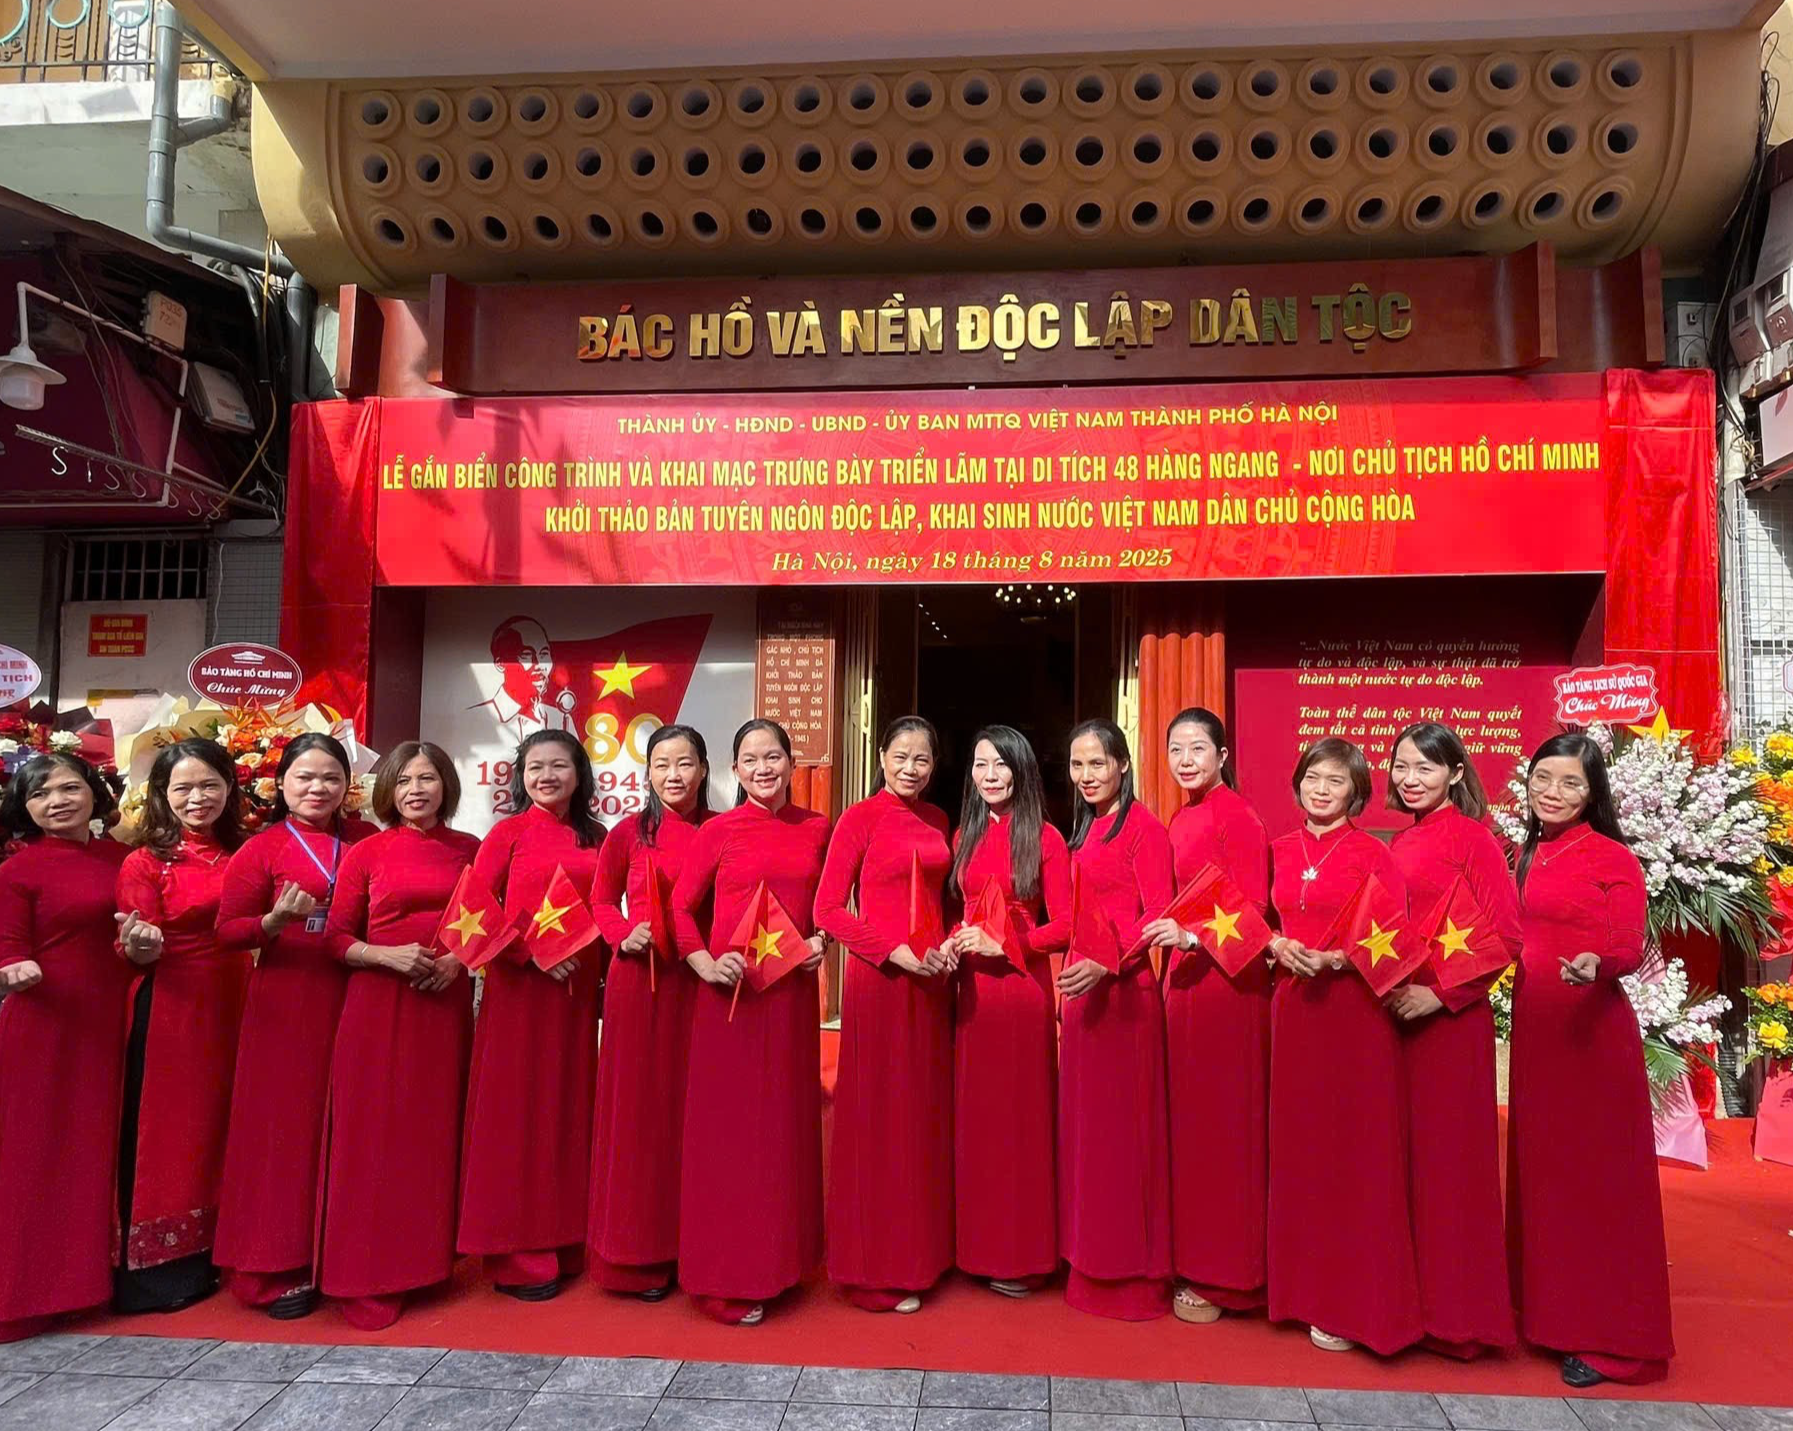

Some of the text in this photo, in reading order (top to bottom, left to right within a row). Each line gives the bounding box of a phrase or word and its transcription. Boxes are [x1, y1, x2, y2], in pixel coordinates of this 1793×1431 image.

[577, 283, 1412, 361] BÁC HỒ VÀ NỀN ĐỘC LẬP DÂN TỘC
[618, 401, 1337, 434] THÀNH ỦY HĐND UBND ỦY BAN MTTQ VIỆT NAM THÀNH PHỐ HÀ NỘI
[383, 435, 1600, 492] LỄ GẮN BIỂN CÔNG TRÌNH VÀ KHAI MẠC TRƯNG BÀY TRIỂN LÃM TẠI DI TÍCH 48 HÀNG NGANG NƠI CHỦ TỊCH HỒ CHÍ MINH
[546, 488, 1415, 536] KHỞI THẢO BẢN TUYÊN NGÔN ĐỘC LẬP, KHAI SINH NƯỚC VIỆT NAM DÂN CHỦ CỘNG HÒA
[771, 548, 1173, 573] Hà Nội, ngày 18 tháng 8 năm 2025
[1356, 639, 1379, 653] Việt
[1384, 641, 1414, 651] Nam
[201, 665, 292, 679] BẢO TÀNG HỒ CHÍ MINH
[1298, 657, 1311, 670] tự
[1317, 657, 1332, 668] do
[1338, 657, 1351, 668] và
[1357, 657, 1379, 670] độc
[1384, 657, 1406, 671] lập,
[1412, 658, 1426, 668] và
[1432, 659, 1446, 670] sự
[1452, 658, 1476, 670] thật
[1481, 657, 1497, 668] đã
[2, 674, 33, 684] TỊCH
[1298, 674, 1484, 688] thành một nước tự do độc lập.
[1576, 678, 1593, 692] TÀNG
[1617, 671, 1635, 691] QUỐC
[1635, 675, 1648, 687] GIA
[206, 682, 286, 697] Chúc Mừng
[811, 696, 823, 704] CHO
[1565, 693, 1650, 713] Chúc Mừng
[811, 709, 822, 717] NAM
[1299, 704, 1522, 721] Toàn thể dân tộc Việt Nam quyết
[1298, 724, 1324, 735] đem
[1330, 721, 1346, 735] tất
[1455, 725, 1476, 739] lực
[1480, 725, 1521, 739] lượng,
[1371, 741, 1384, 752] và
[1490, 742, 1522, 756] vững
